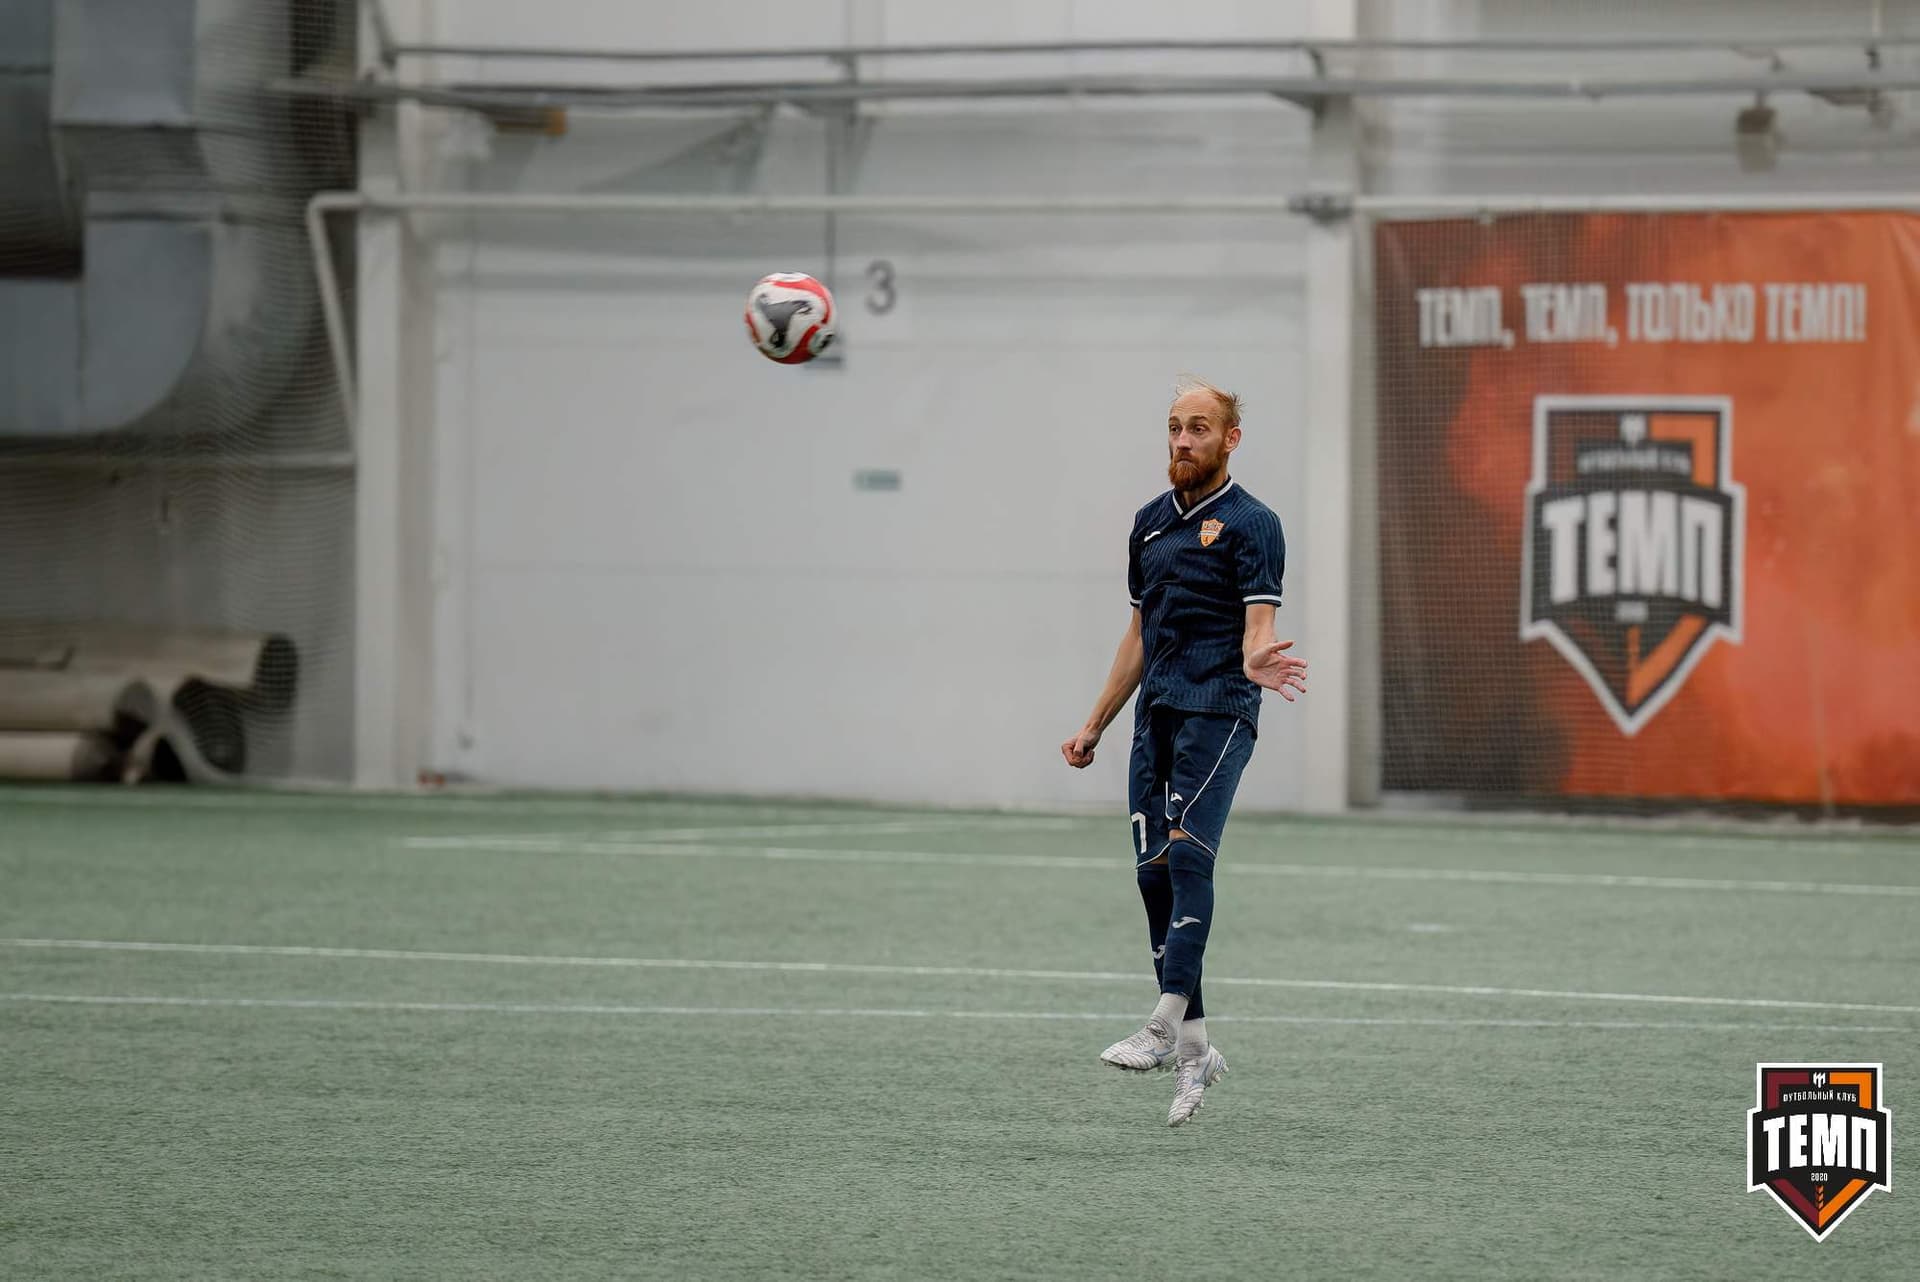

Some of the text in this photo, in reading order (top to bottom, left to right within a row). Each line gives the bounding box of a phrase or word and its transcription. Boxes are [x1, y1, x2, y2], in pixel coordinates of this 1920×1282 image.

[865, 260, 896, 316] 3
[1416, 282, 1867, 349] ТЕМП, ТЕМП, ТОЛЬКО ТЕМП!
[1542, 491, 1723, 608] ТЕМП
